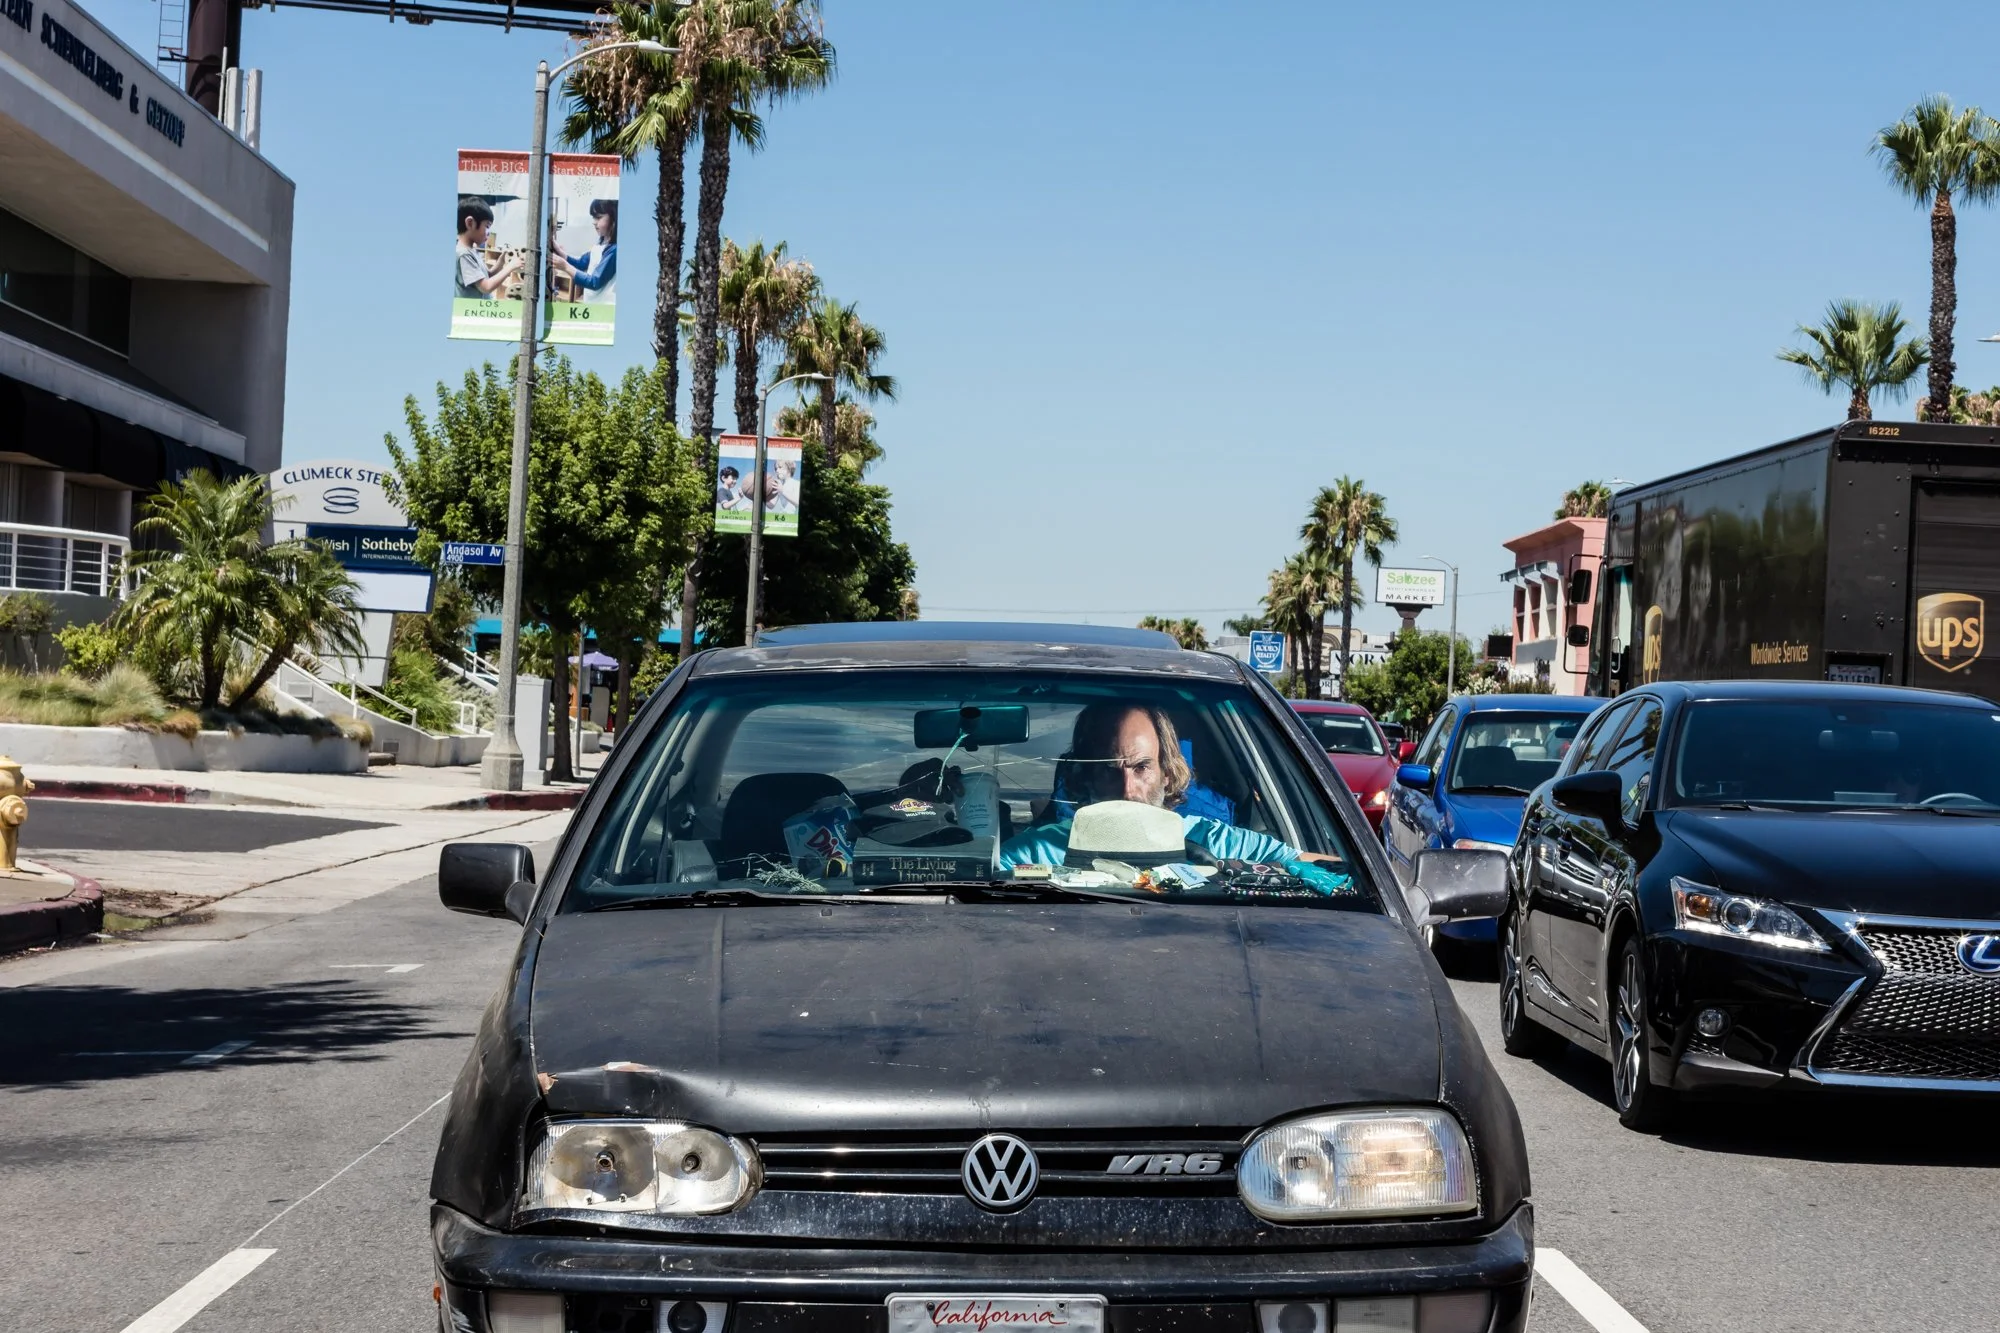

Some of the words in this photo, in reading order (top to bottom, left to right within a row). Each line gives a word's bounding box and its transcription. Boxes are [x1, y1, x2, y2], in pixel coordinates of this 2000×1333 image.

[129, 83, 140, 114] &
[461, 159, 497, 173] Think
[552, 164, 575, 176] Start
[479, 300, 499, 308] LOS
[464, 309, 513, 319] ENCINOS
[569, 307, 590, 320] K-6
[1868, 426, 1900, 436] 162212
[283, 466, 354, 485] CLUMECK
[356, 469, 402, 492] STEN
[774, 514, 786, 522] K-6
[361, 553, 403, 561] INTERNATIONAL
[446, 543, 484, 557] Andasol
[489, 546, 502, 558] Av
[446, 554, 464, 562] 4900
[1386, 571, 1437, 585] Sabzee
[1385, 593, 1435, 601] MARKET
[1922, 616, 1980, 660] ups
[1750, 641, 1782, 665] Worldwide
[1783, 640, 1809, 663] Services
[888, 856, 914, 870] The
[916, 857, 956, 874] Living
[899, 870, 947, 882] Lincoln
[1106, 1152, 1224, 1176] VR6
[932, 1300, 1068, 1332] California
